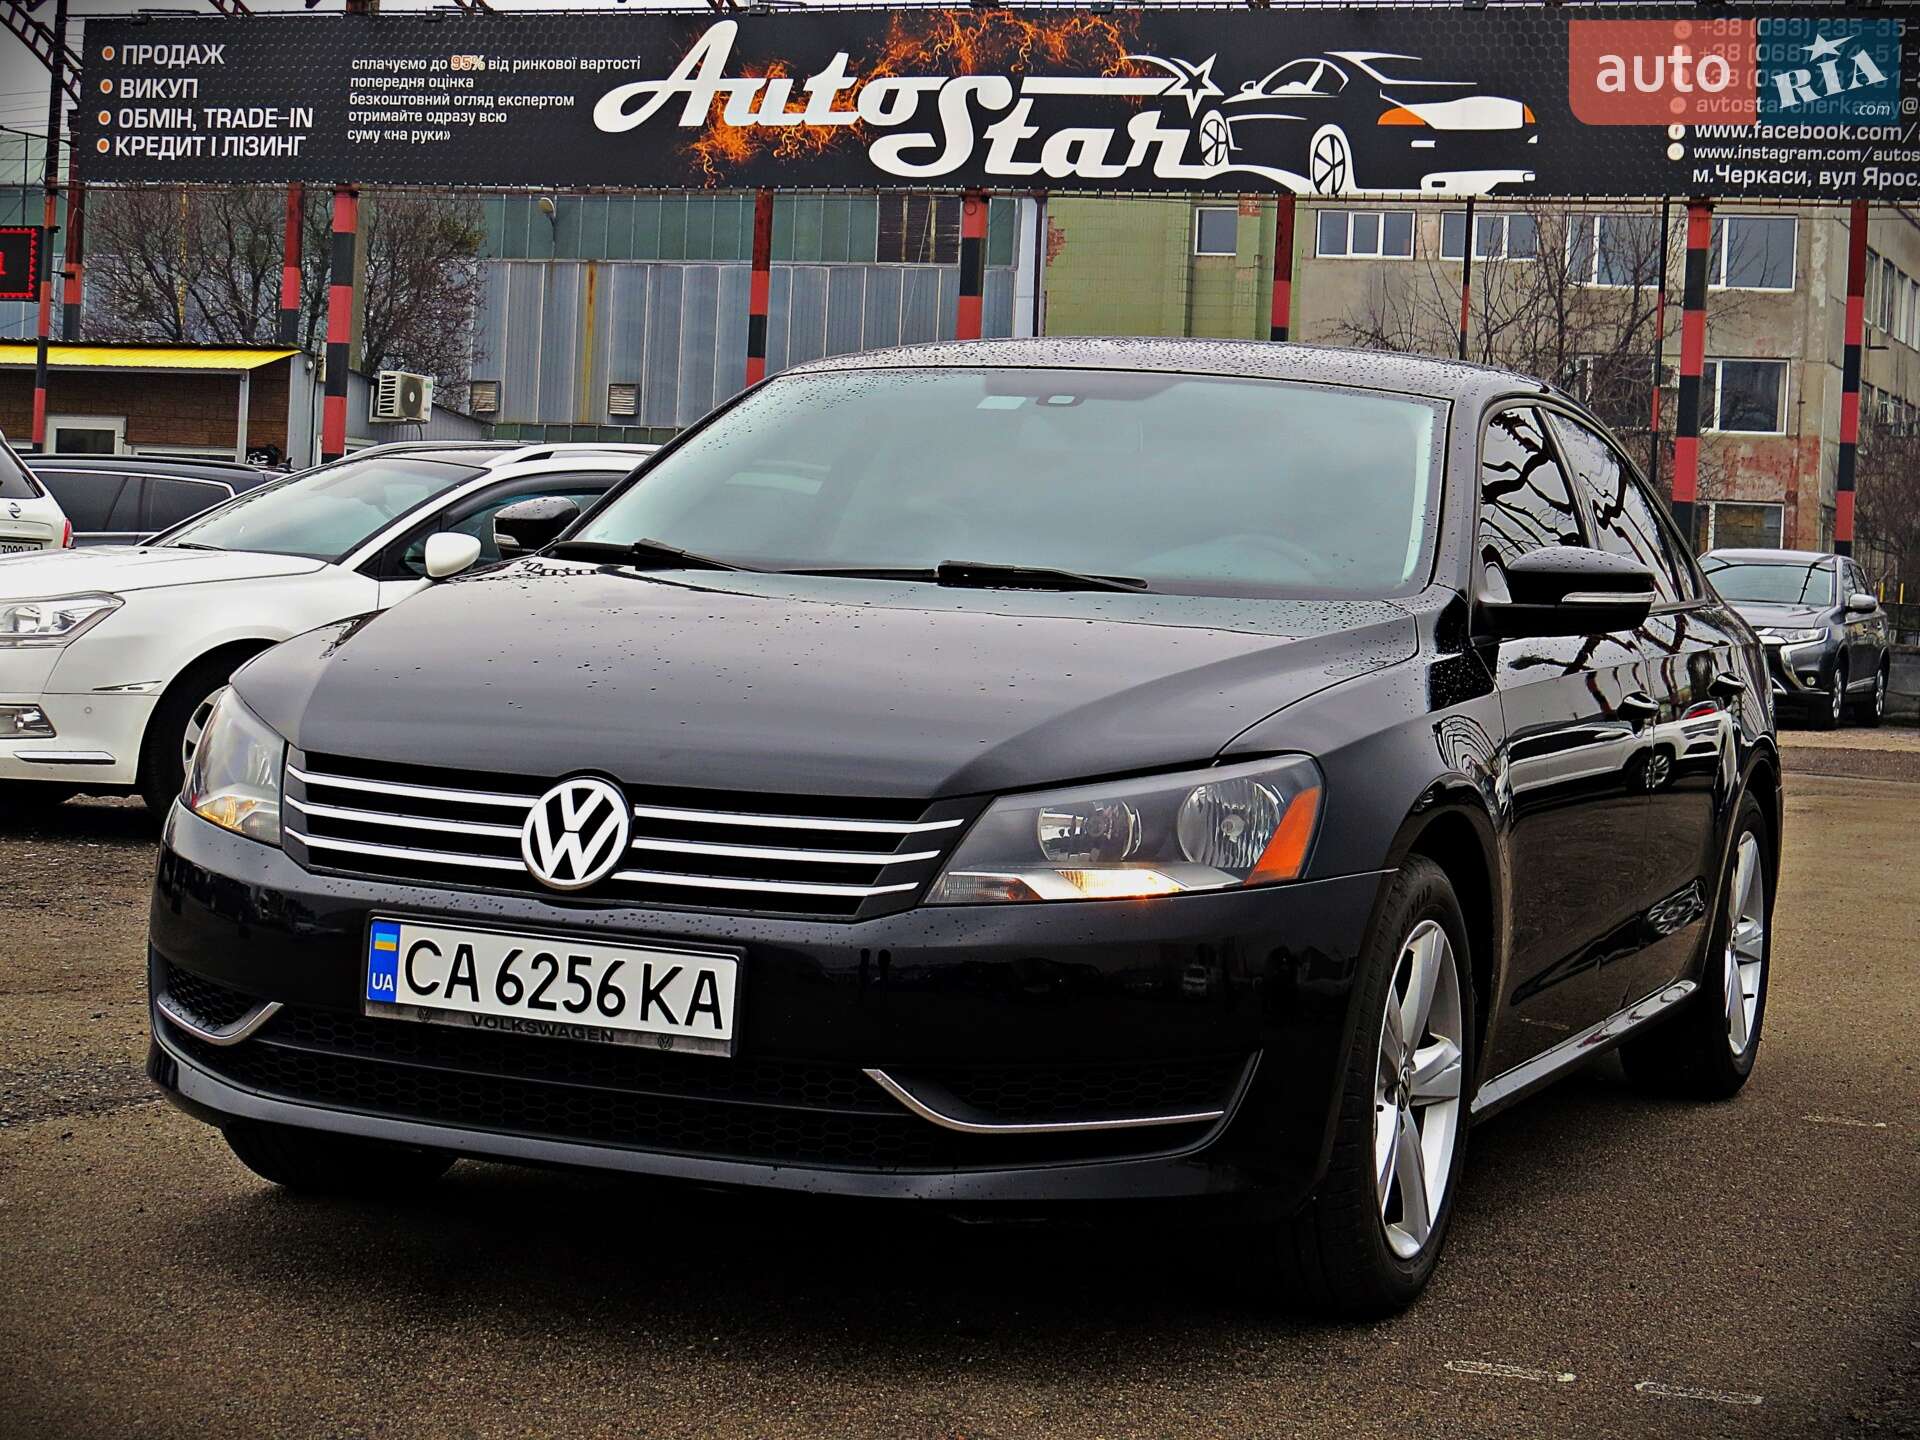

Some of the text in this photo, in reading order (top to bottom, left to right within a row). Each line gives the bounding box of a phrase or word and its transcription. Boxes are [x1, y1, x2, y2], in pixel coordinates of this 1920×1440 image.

[121, 44, 226, 69] ПРОДАЖ
[352, 54, 641, 77] сплачуємо до 95% від ринкової вартості
[120, 78, 198, 99] ВИКУП
[350, 75, 474, 92] попередня оцінка
[349, 93, 574, 109] безкоштовний огляд експертом
[118, 107, 313, 131] ОБМІН, TRADE-IN
[348, 110, 507, 126] отримайте одразу всю
[347, 130, 381, 145] суму
[1695, 120, 1920, 144] www.facebook.com/
[115, 136, 205, 160] КРЕДИТ
[221, 136, 306, 157] ЛІЗИНГ
[1819, 170, 1856, 190] вул
[1862, 166, 1920, 191] Ярос
[371, 971, 394, 992] UA
[404, 939, 723, 1030] CA 6256 KA
[471, 1015, 616, 1043] VOLKSWAGEN
